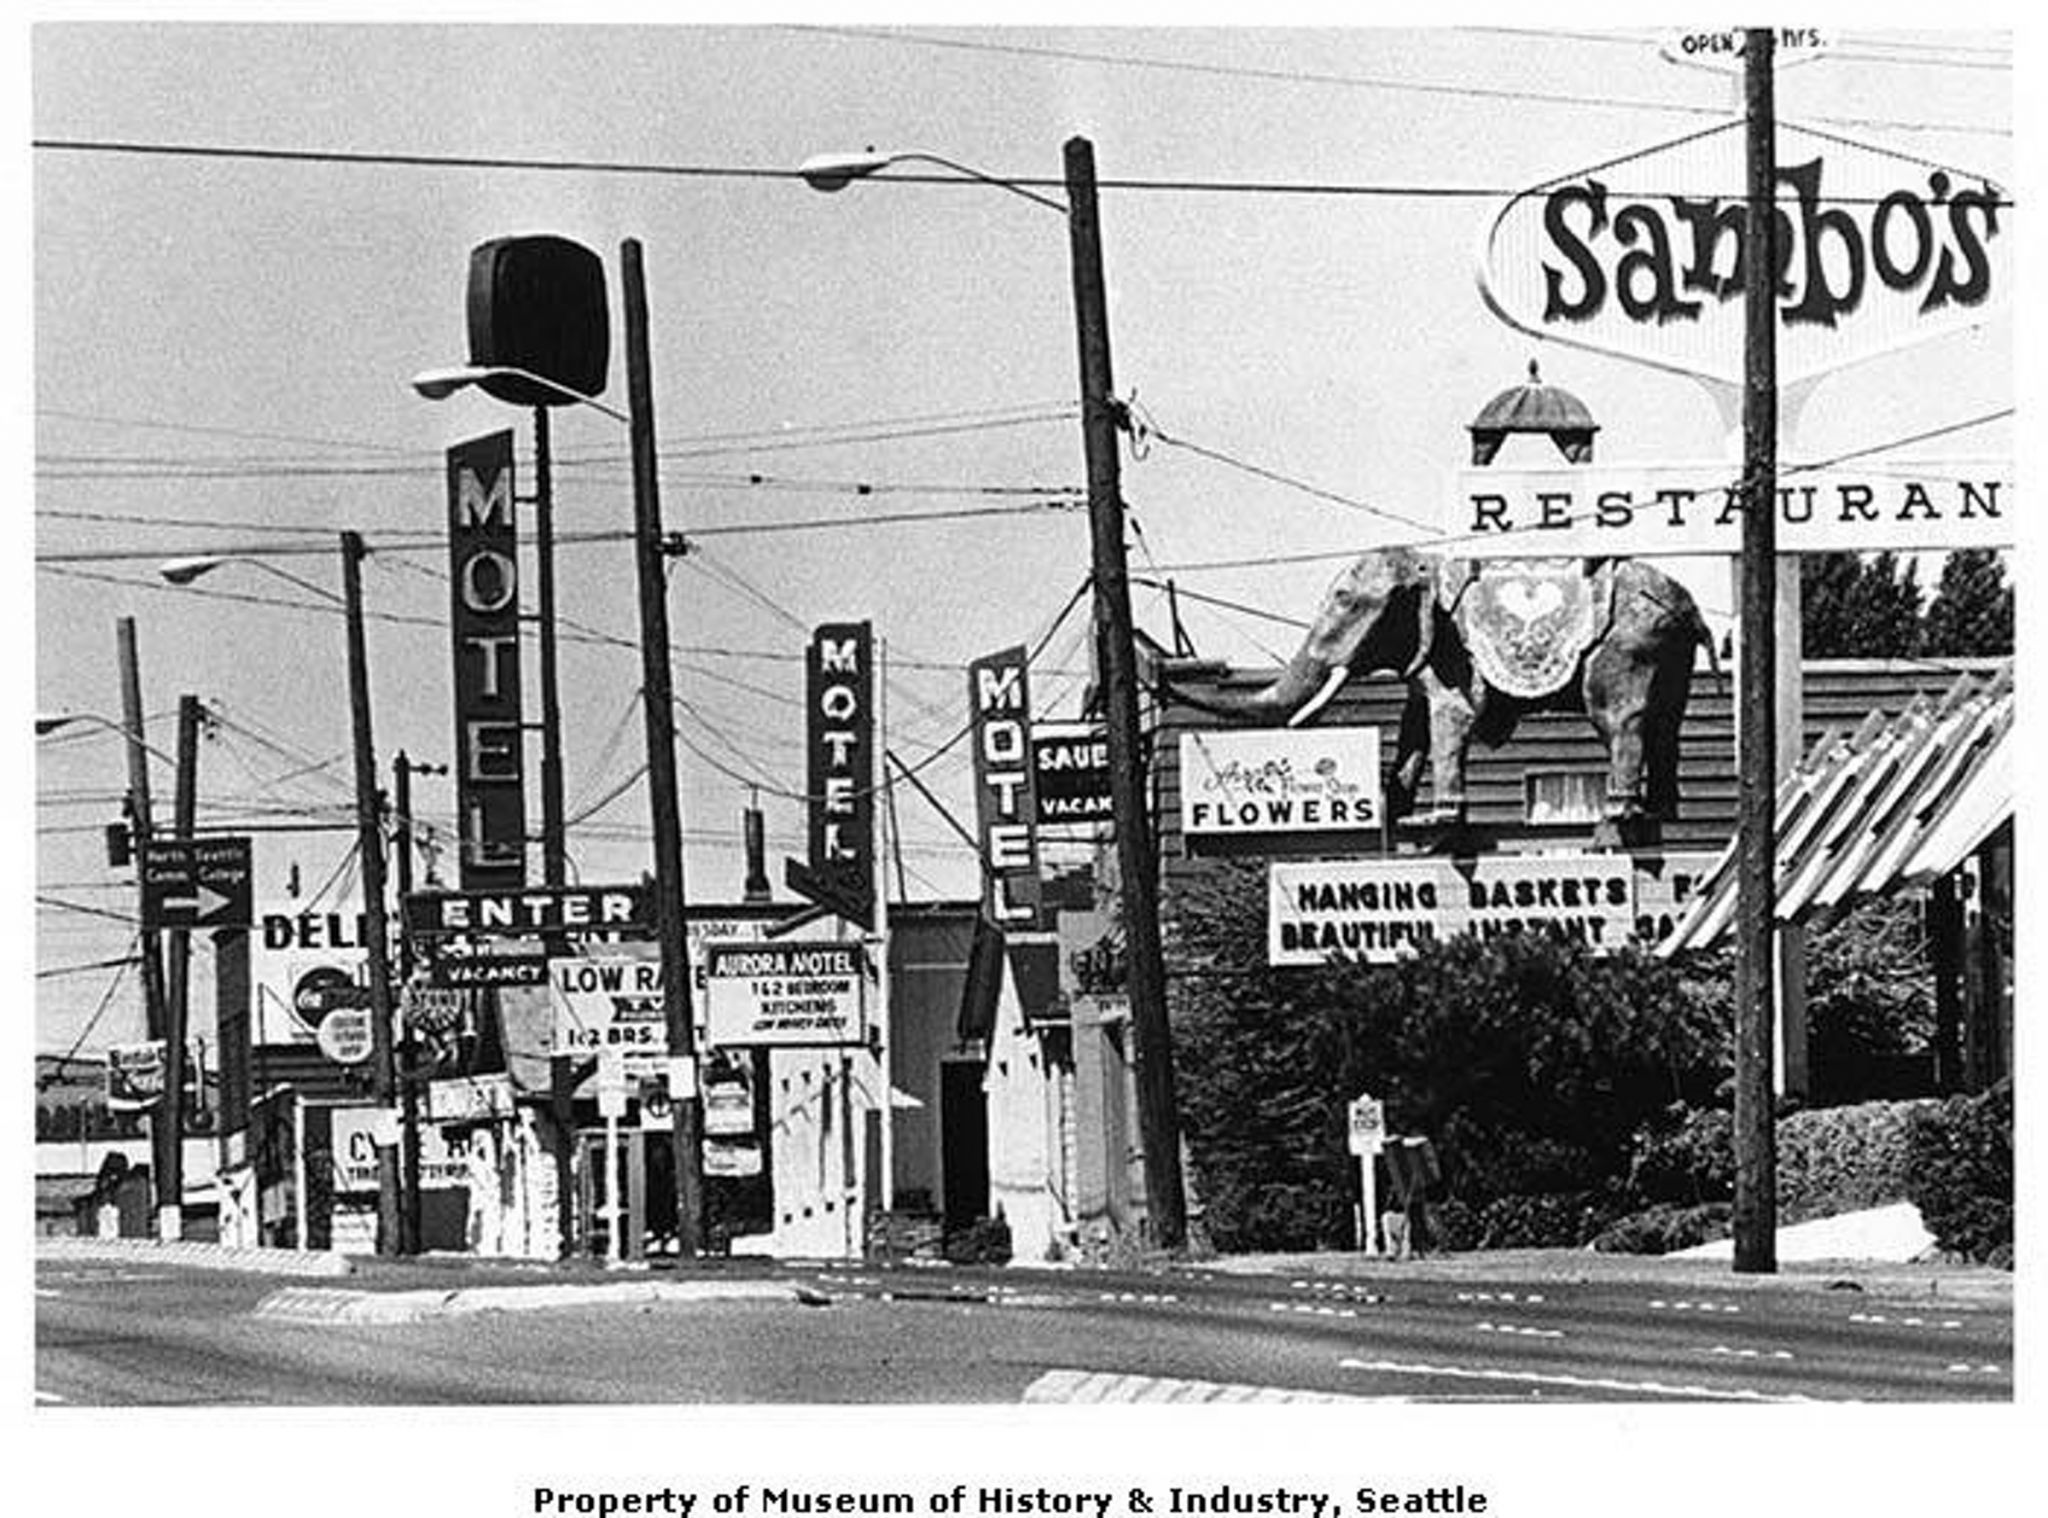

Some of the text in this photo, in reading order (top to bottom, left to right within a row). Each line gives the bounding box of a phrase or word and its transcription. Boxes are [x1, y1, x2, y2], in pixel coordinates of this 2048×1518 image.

[1681, 34, 1734, 54] OPEN
[1542, 157, 2000, 329] Sambo's
[1470, 482, 2003, 532] RESTAURAN
[458, 466, 522, 866] MOTEL
[820, 638, 858, 860] MOTEL
[977, 666, 1034, 920] MOTEL
[1041, 795, 1113, 815] VACAN
[1193, 798, 1373, 827] FLOWERS
[442, 894, 633, 927] ENTER
[1299, 877, 1628, 912] HANGING BASKETS
[448, 965, 541, 981] VACANCY
[563, 967, 623, 992] LOW
[715, 952, 855, 976] AURORA MOTEL
